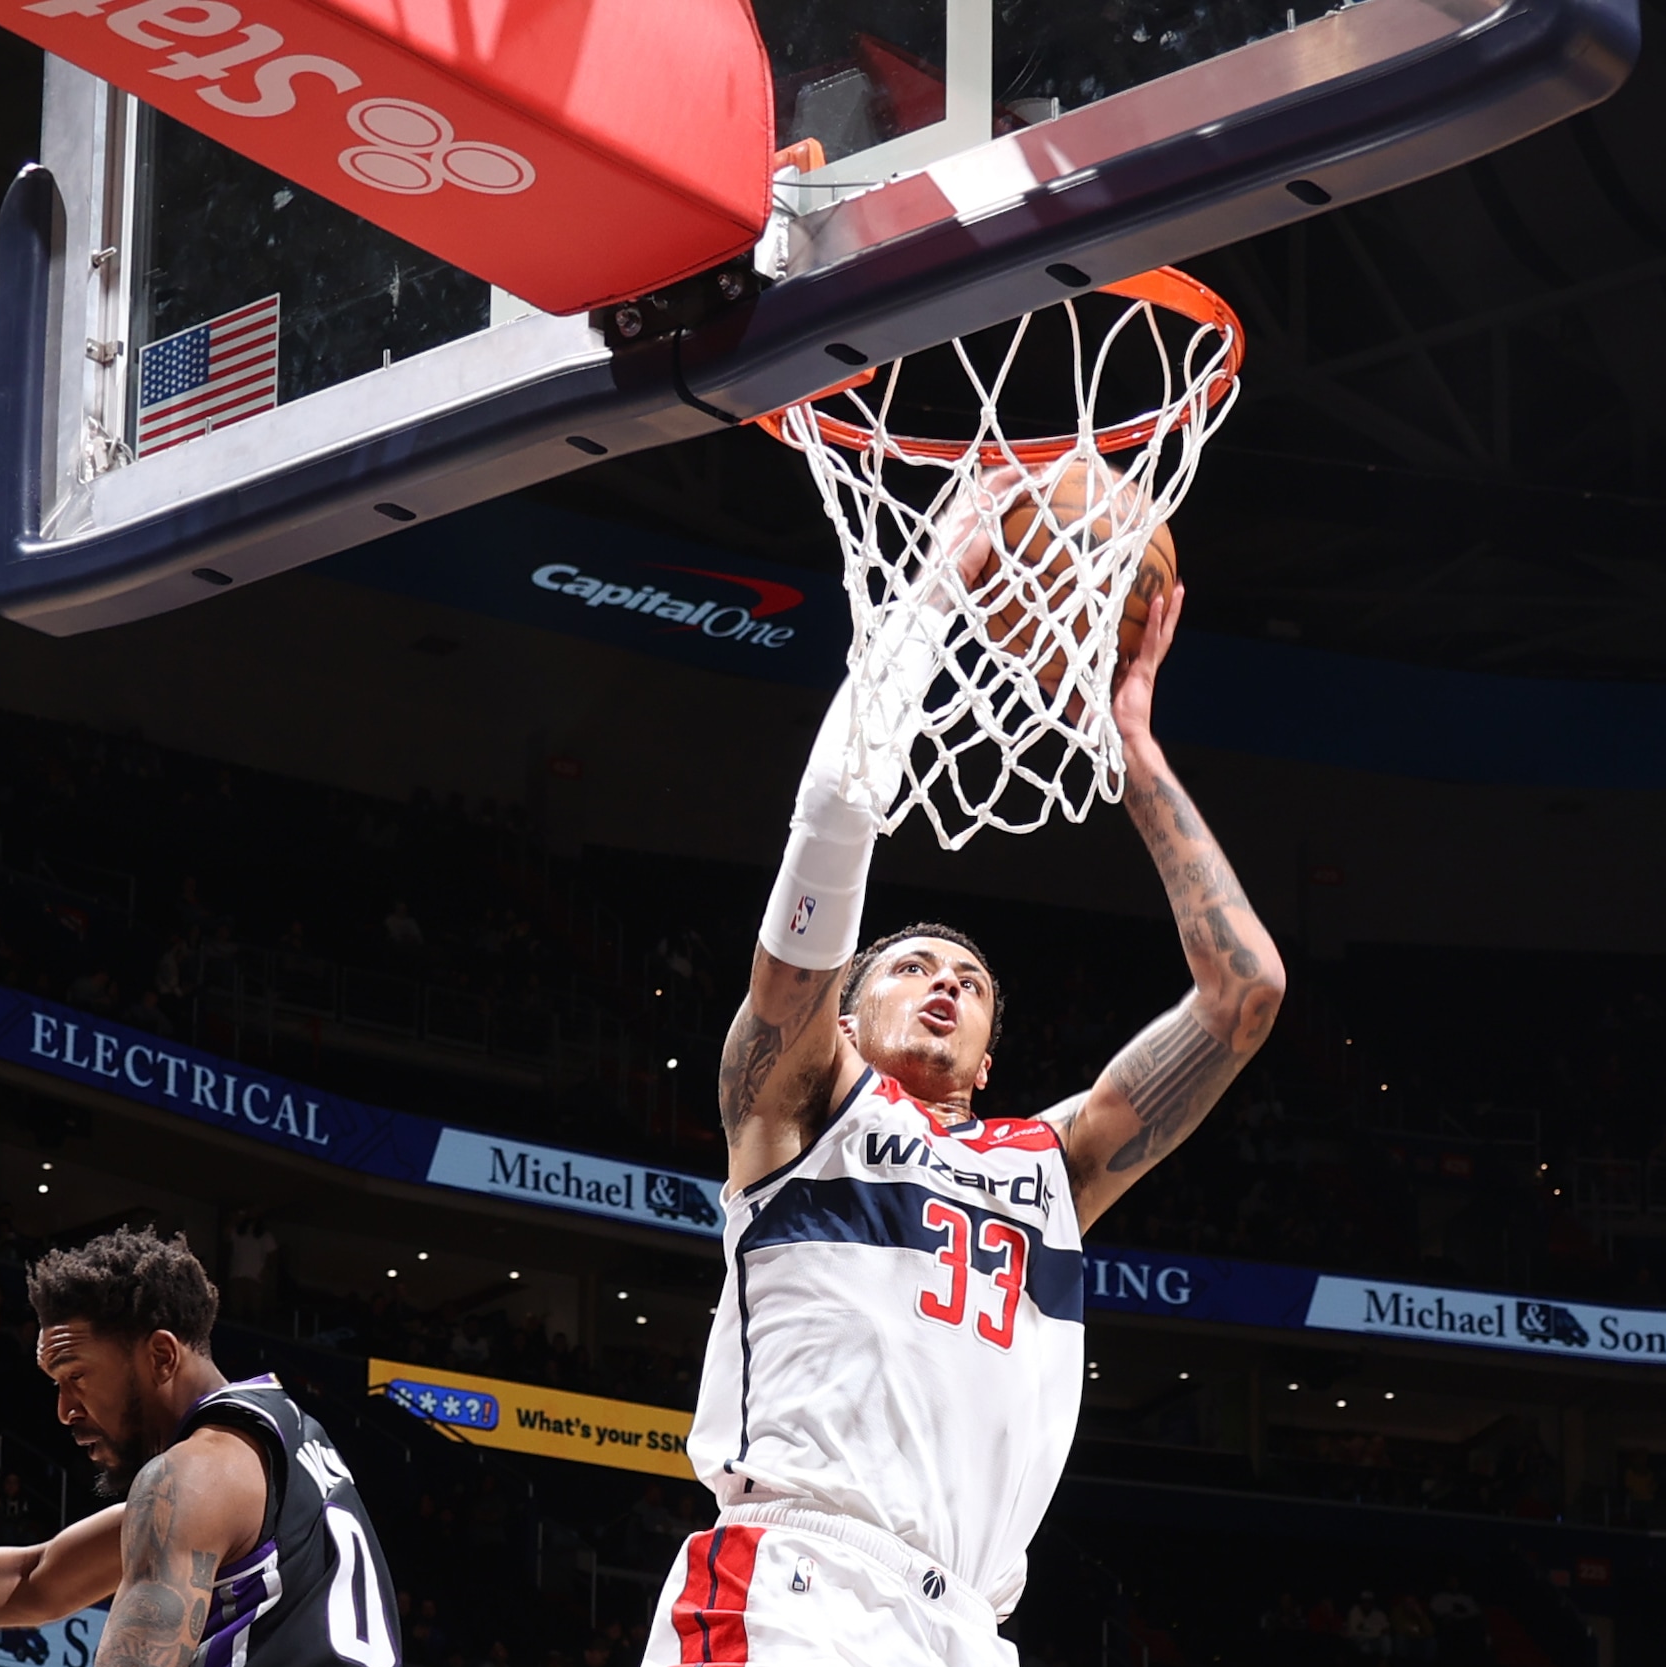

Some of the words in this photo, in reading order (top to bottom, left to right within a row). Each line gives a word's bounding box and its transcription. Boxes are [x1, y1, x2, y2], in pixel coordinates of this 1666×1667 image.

[29, 1011, 331, 1147] ELECTRICAL
[490, 1146, 633, 1210] Michael
[866, 1132, 1055, 1215] wizards
[914, 1200, 1029, 1353] 33
[1085, 1260, 1192, 1306] ING
[1364, 1289, 1505, 1337] Michael
[1599, 1317, 1666, 1355] Son
[517, 1405, 588, 1440] What's
[593, 1421, 643, 1452] your
